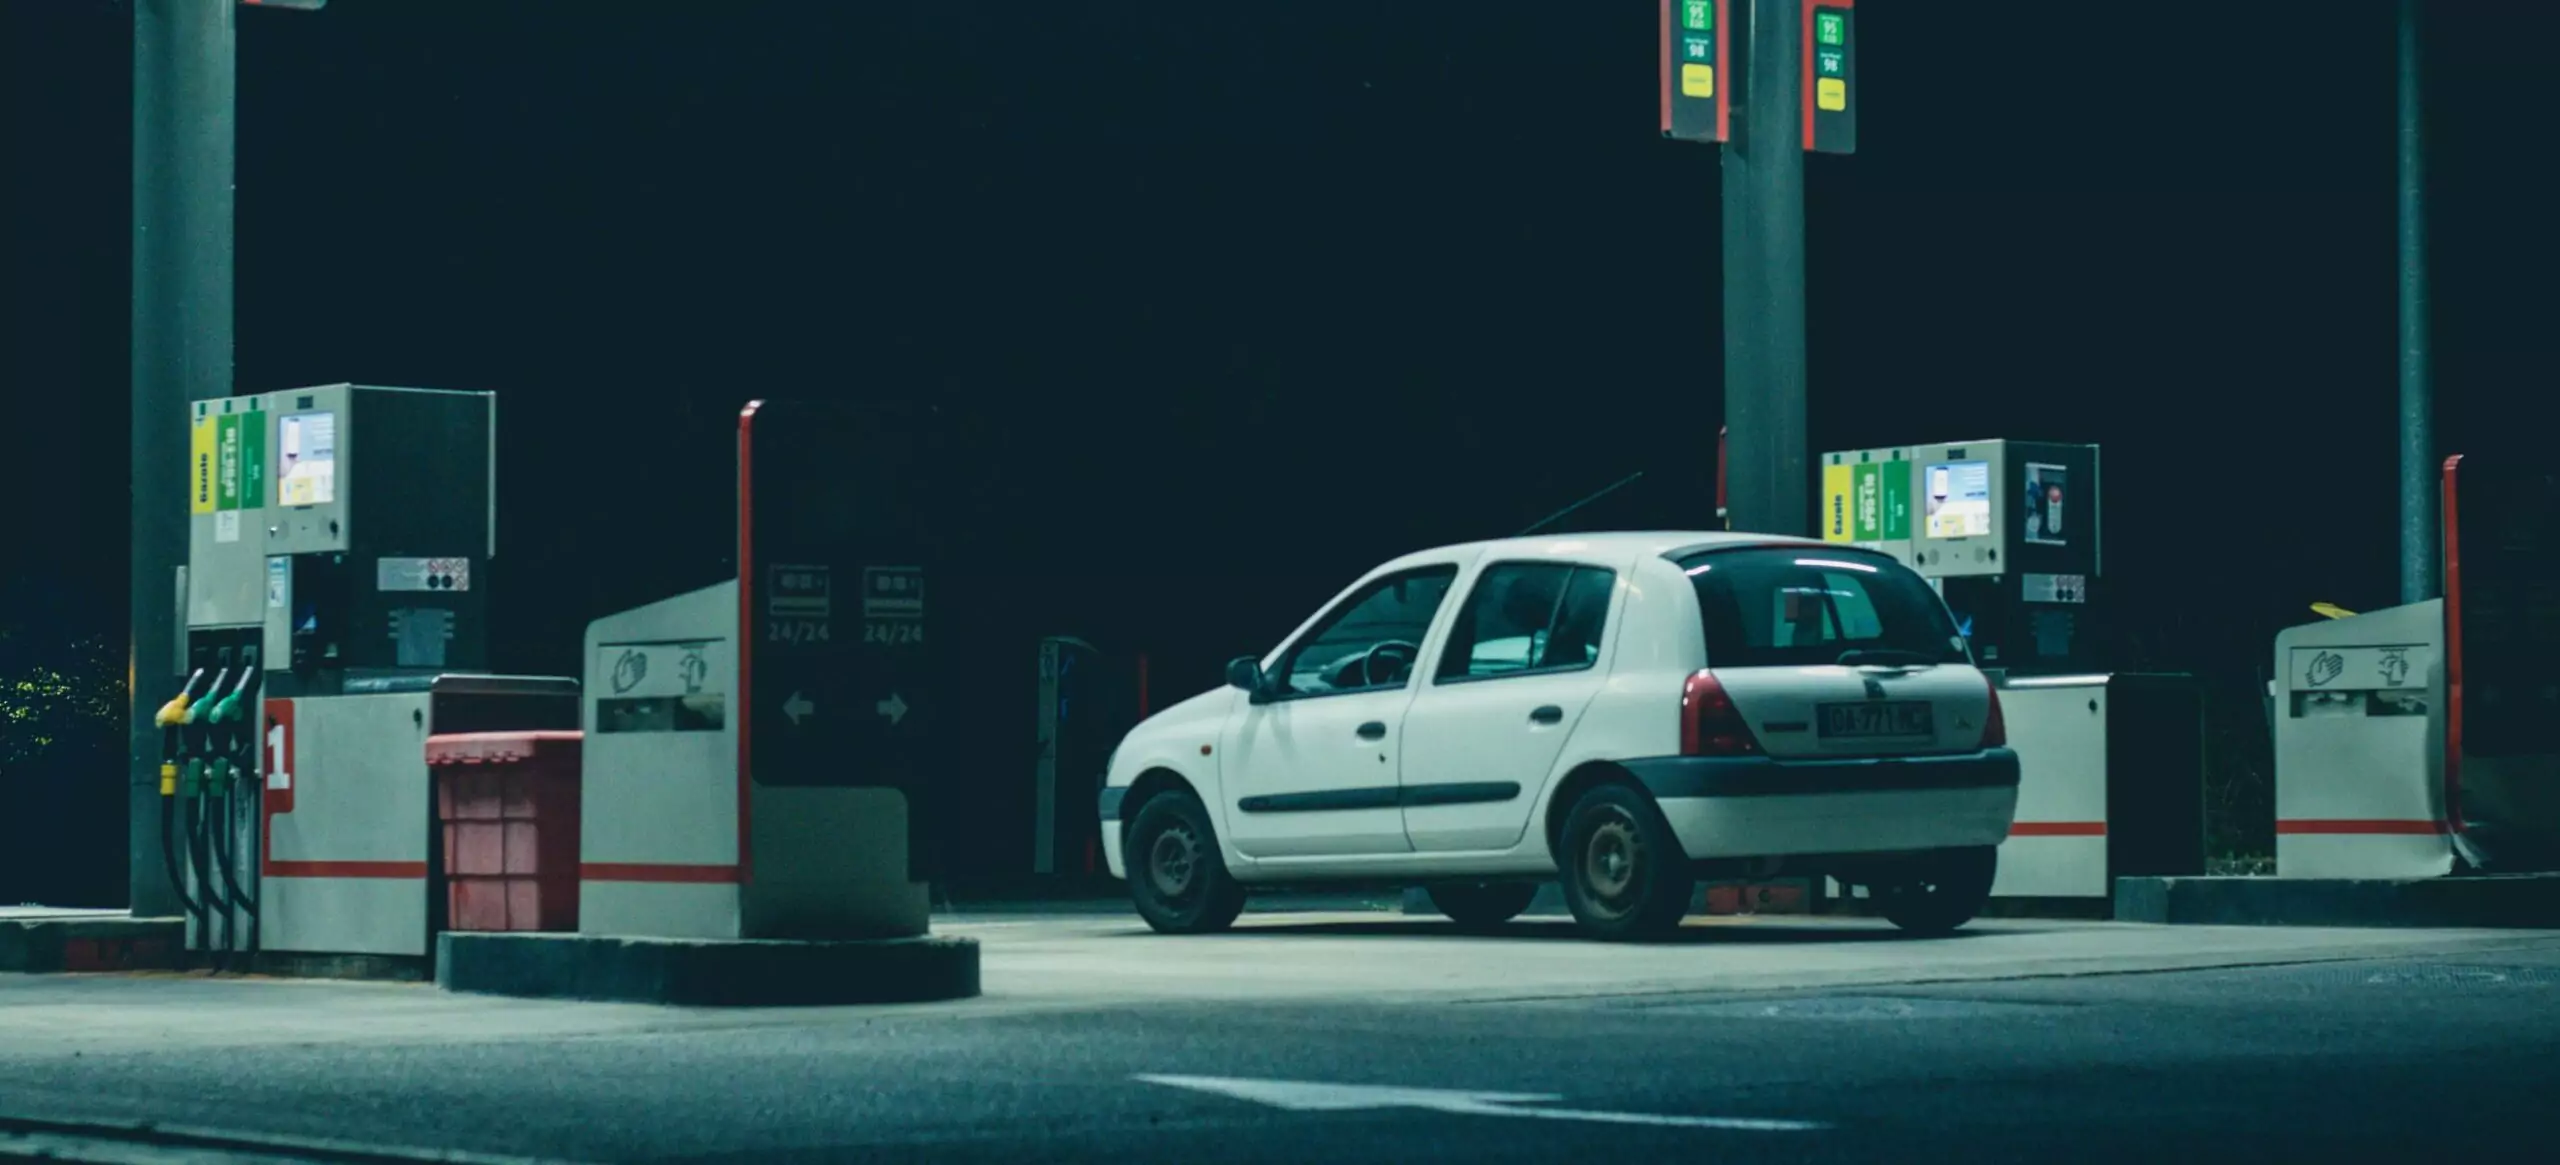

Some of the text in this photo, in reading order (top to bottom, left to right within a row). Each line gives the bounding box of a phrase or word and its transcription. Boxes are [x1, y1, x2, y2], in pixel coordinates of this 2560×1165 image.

[1689, 44, 1705, 57] 98
[1823, 58, 1838, 72] 98
[768, 621, 830, 646] 24/24
[864, 623, 923, 646] 24/24
[266, 724, 291, 790] 1
